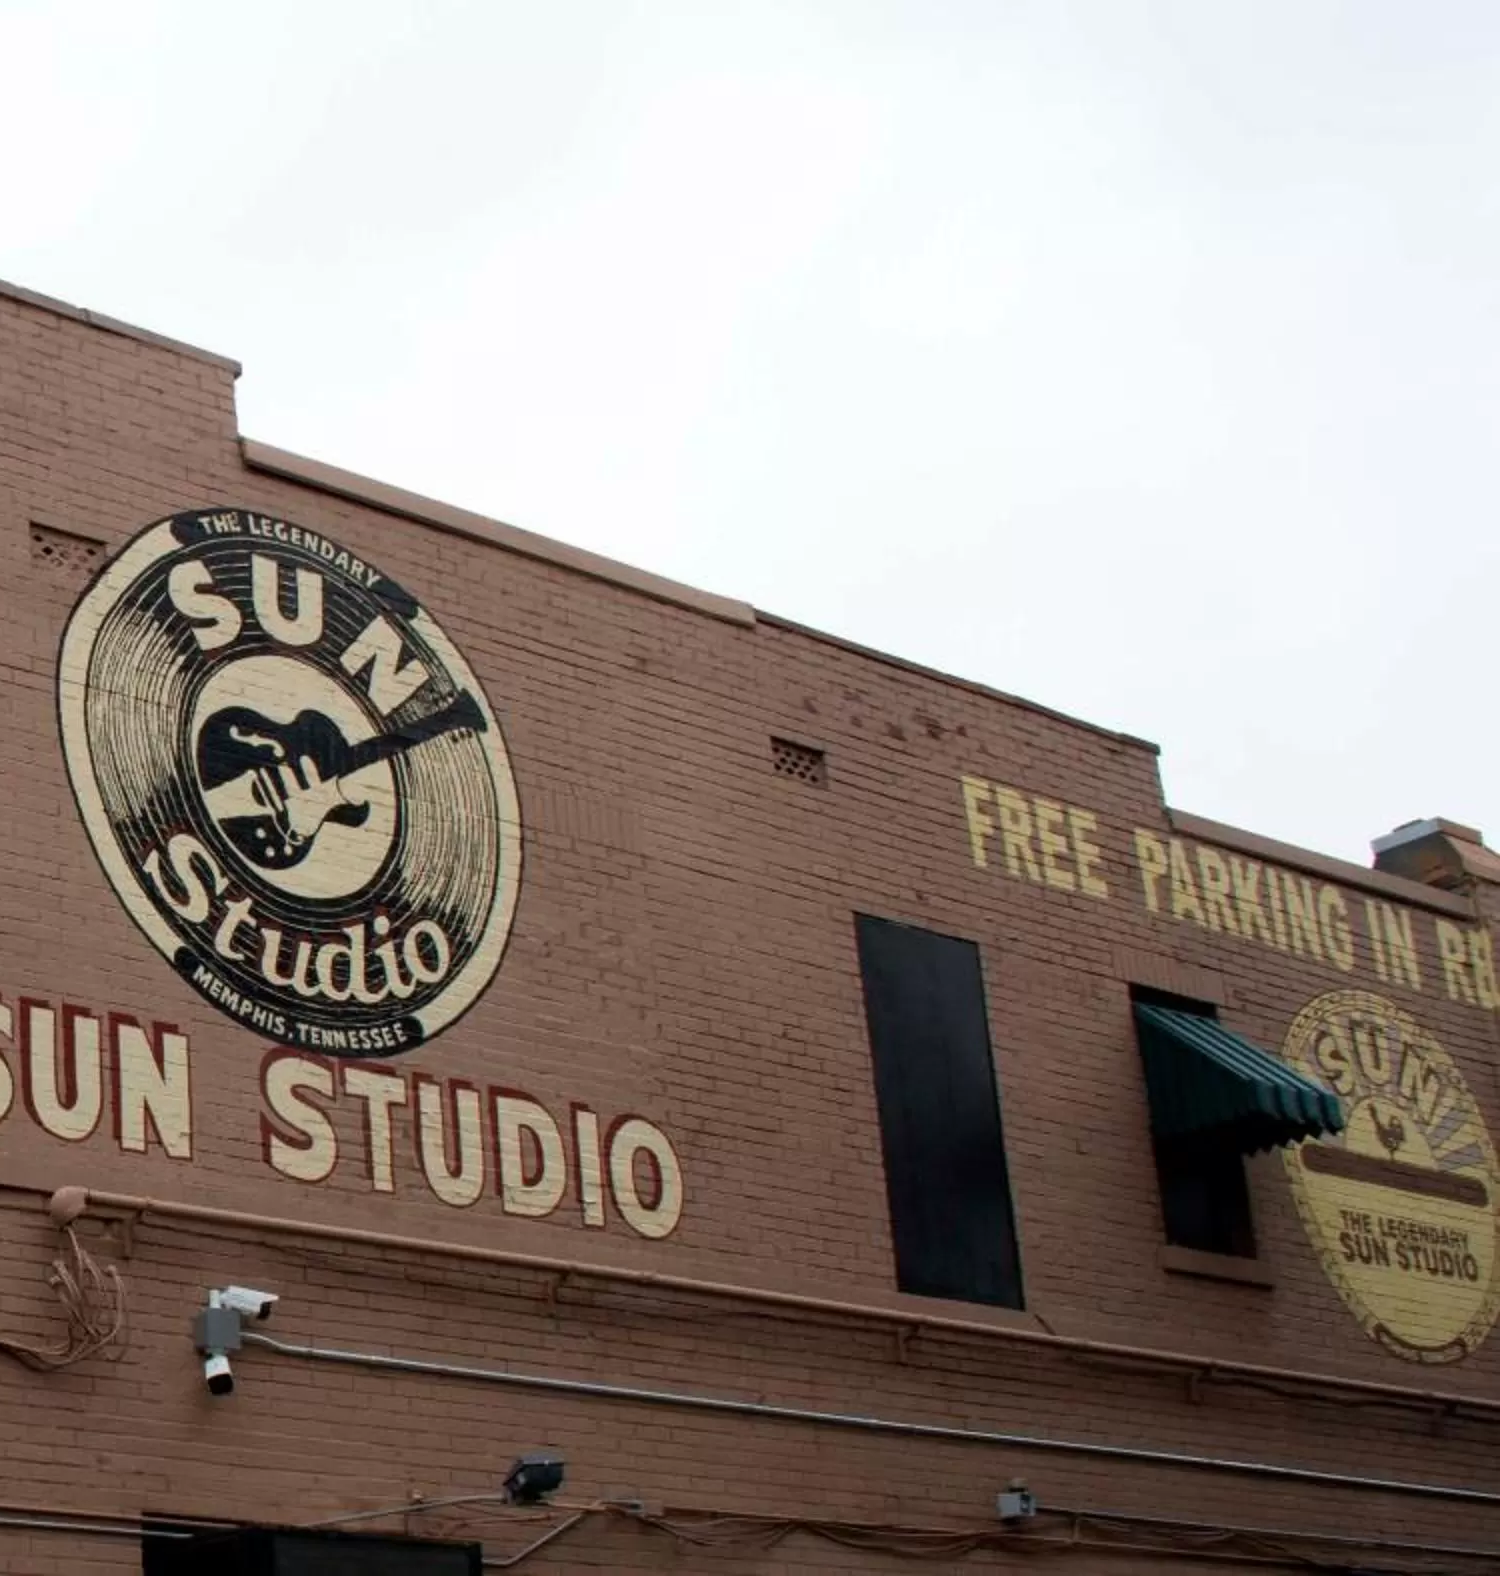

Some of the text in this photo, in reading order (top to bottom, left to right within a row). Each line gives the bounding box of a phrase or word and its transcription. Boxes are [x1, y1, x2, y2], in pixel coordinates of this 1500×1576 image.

[197, 512, 383, 589] THE LEGENDARY
[167, 552, 430, 715] SUN
[142, 832, 450, 1004] Studio
[961, 775, 1108, 899] FREE
[1134, 827, 1354, 972] PARKING
[1363, 898, 1422, 992] IN
[296, 1022, 408, 1050] TENNESSEE
[1315, 1018, 1441, 1127] SUN
[259, 1045, 684, 1240] STUDIO
[1338, 1230, 1479, 1282] SUN STUDIO
[1339, 1208, 1469, 1250] THE LEGENDARY
